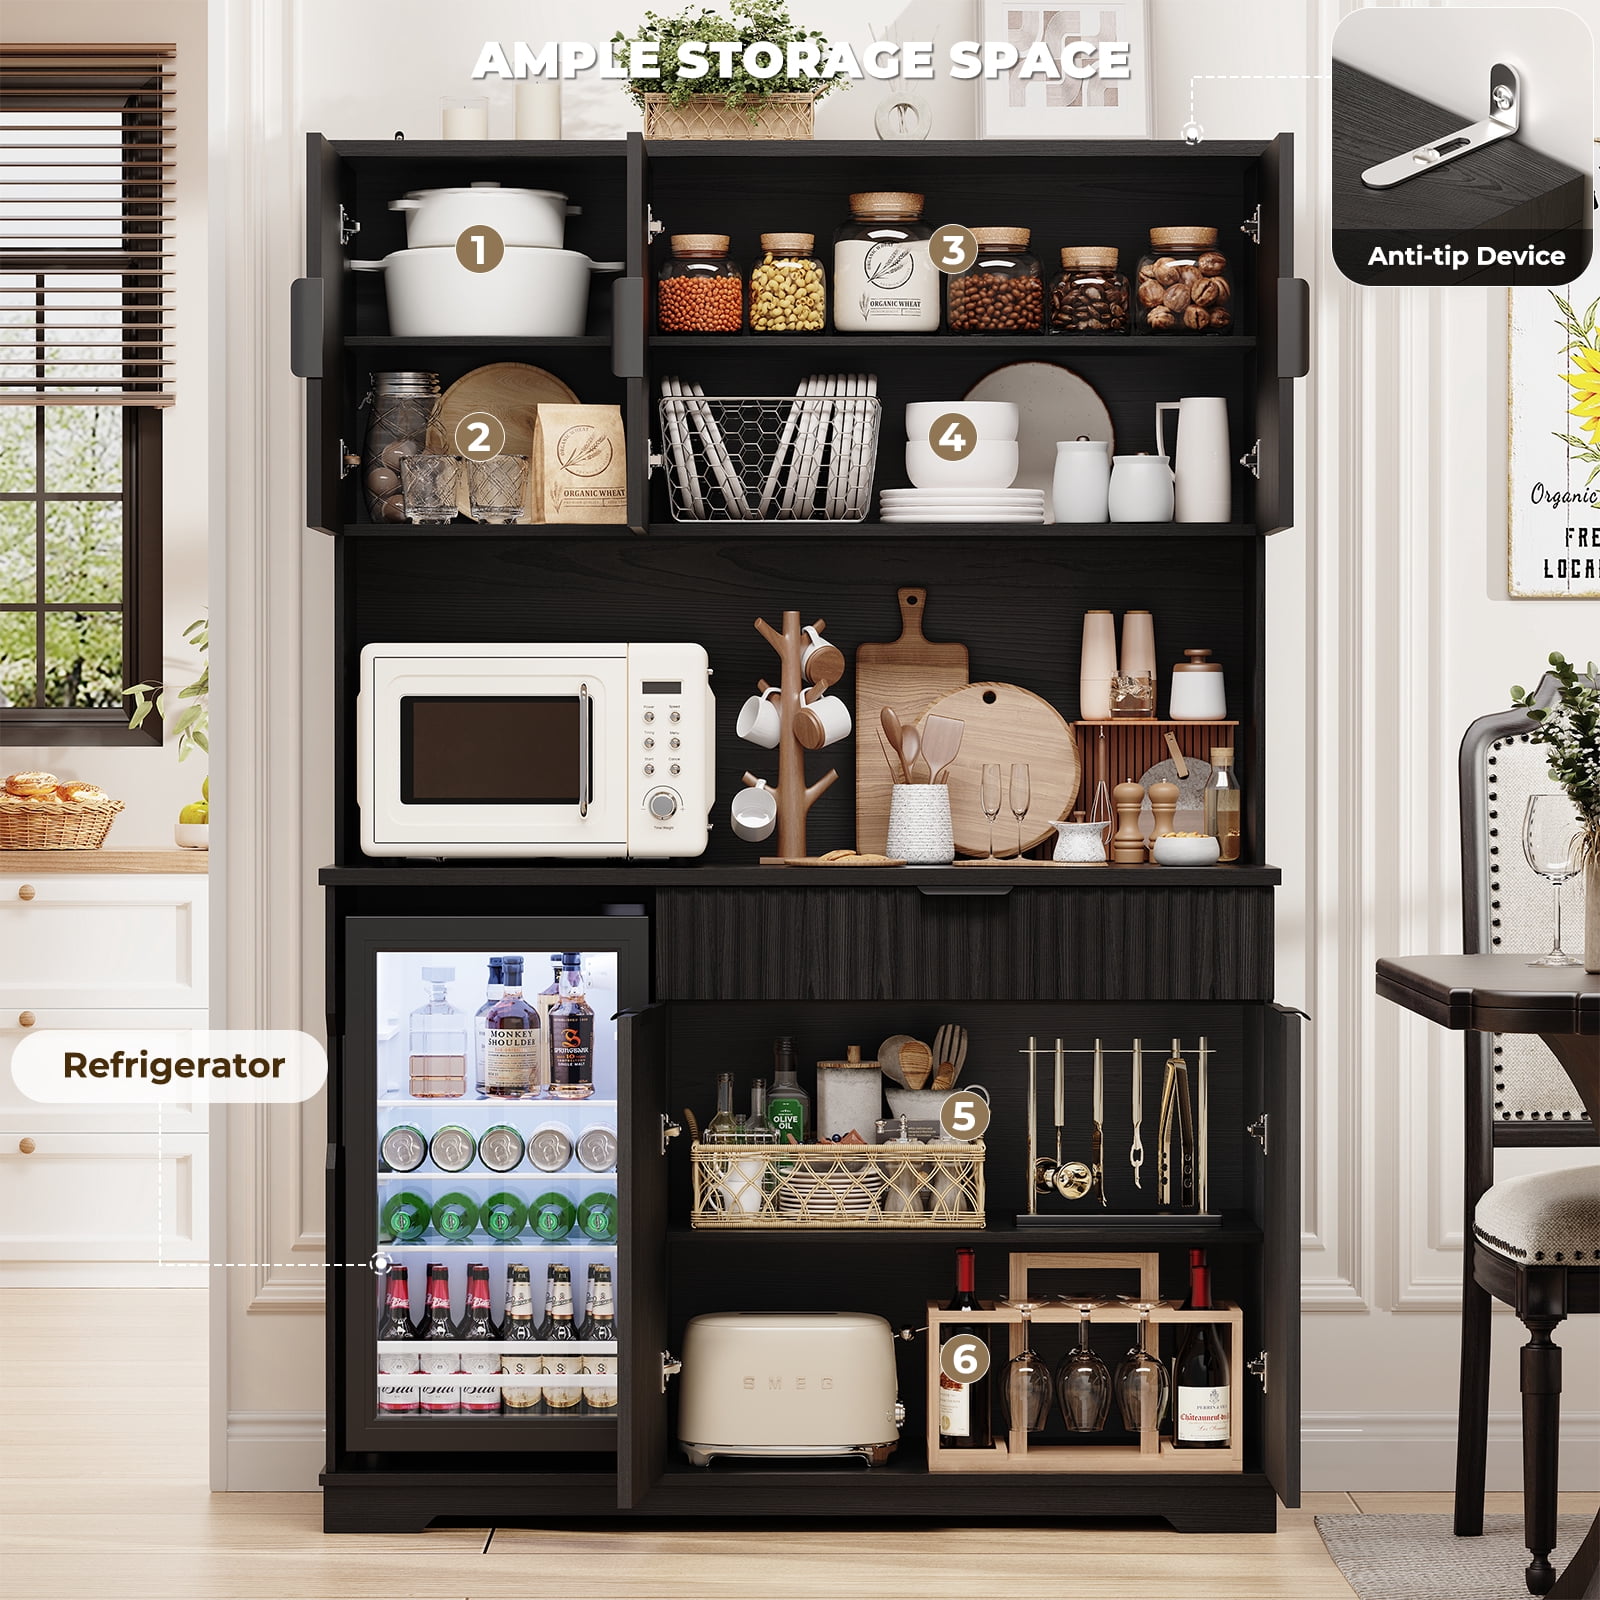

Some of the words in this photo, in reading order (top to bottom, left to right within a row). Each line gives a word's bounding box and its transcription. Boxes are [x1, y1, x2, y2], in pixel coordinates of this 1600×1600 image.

[599, 489, 626, 497] WHEAT
[1531, 482, 1598, 509] Organic
[1544, 559, 1600, 579] LOCA
[490, 1030, 533, 1038] MONKEY
[488, 1038, 536, 1046] SHOULDER
[773, 1115, 798, 1123] OLIVE
[743, 1376, 833, 1390] SMEG
